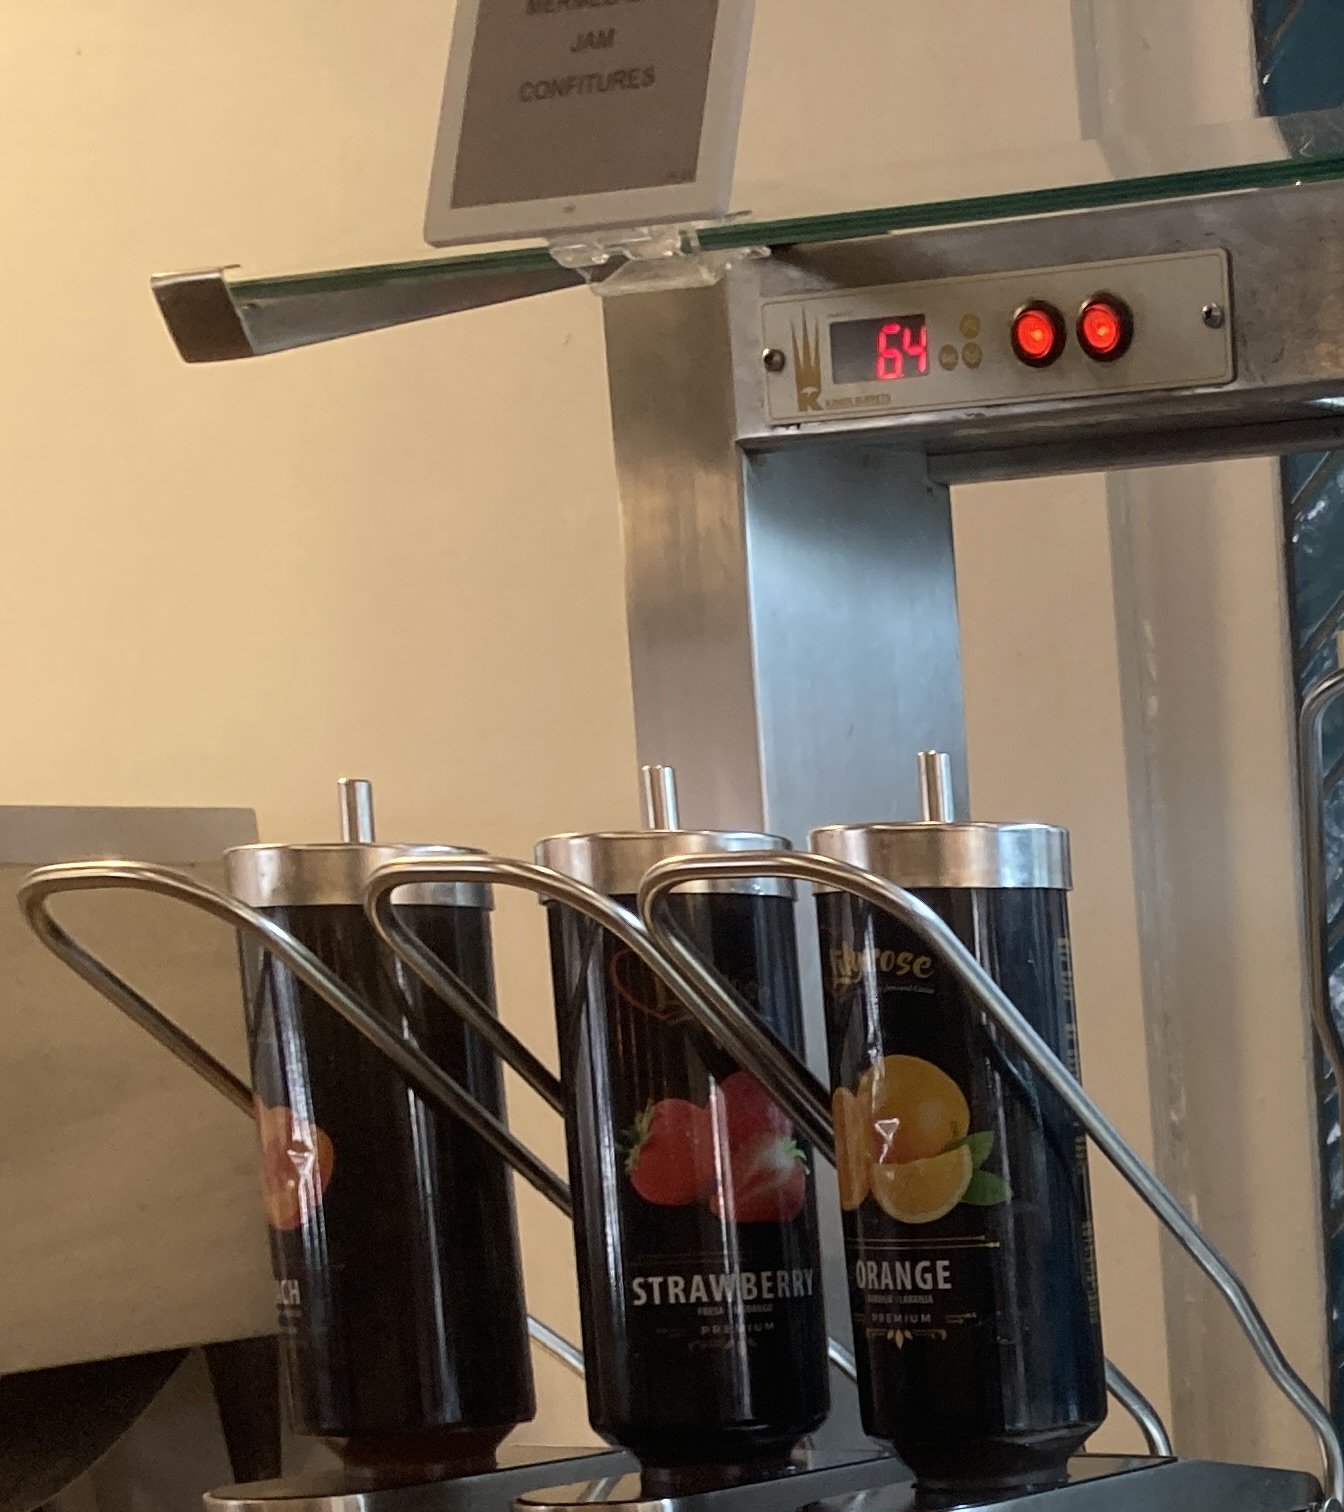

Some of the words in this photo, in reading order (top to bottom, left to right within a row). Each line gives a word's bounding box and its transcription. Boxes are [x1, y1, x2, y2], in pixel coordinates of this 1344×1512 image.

[570, 27, 616, 52] JAM
[519, 67, 656, 102] CONFITURES
[877, 323, 927, 379] 64
[632, 1268, 814, 1306] STRAWBERRY
[856, 1259, 952, 1290] ORANGE
